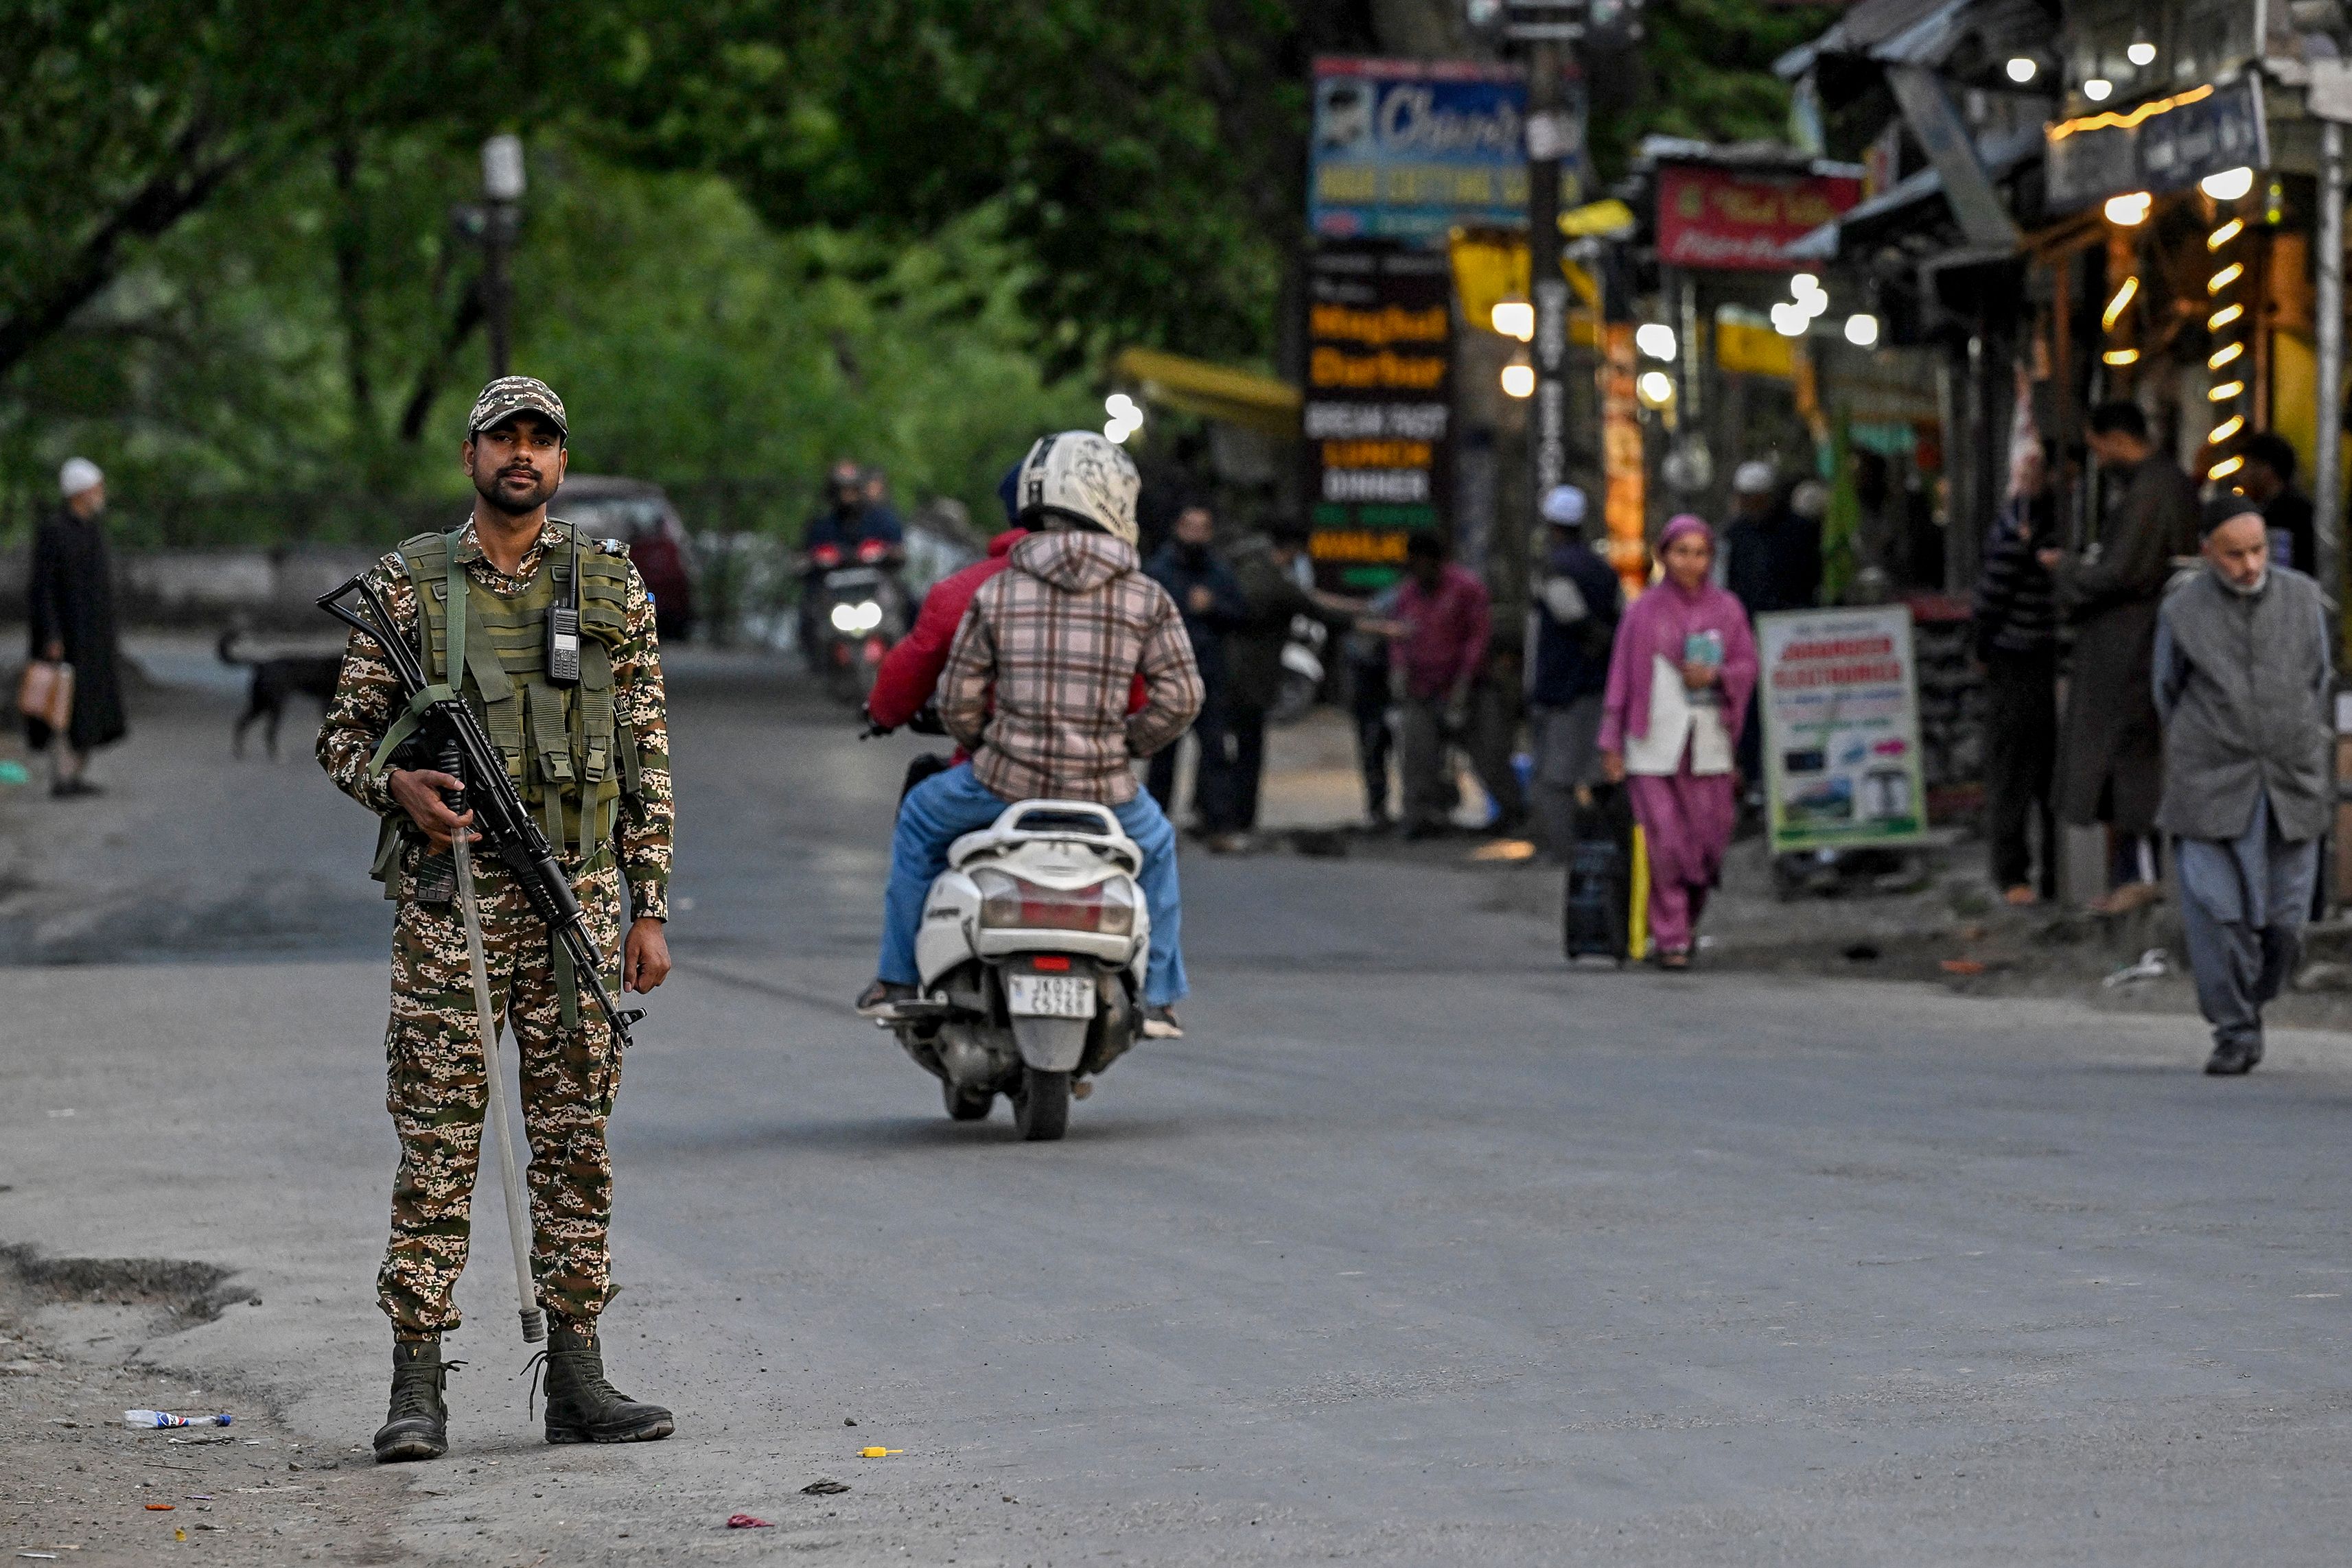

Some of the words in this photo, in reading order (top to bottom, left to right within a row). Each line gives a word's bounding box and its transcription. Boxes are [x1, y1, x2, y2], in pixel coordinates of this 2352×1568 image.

[1312, 305, 1446, 342] Mughal
[1312, 348, 1445, 387] Darbar
[1307, 405, 1386, 436] BREAK
[1389, 405, 1447, 437] FAST
[1325, 441, 1430, 467] LUNCH
[1325, 469, 1428, 500] DINNER
